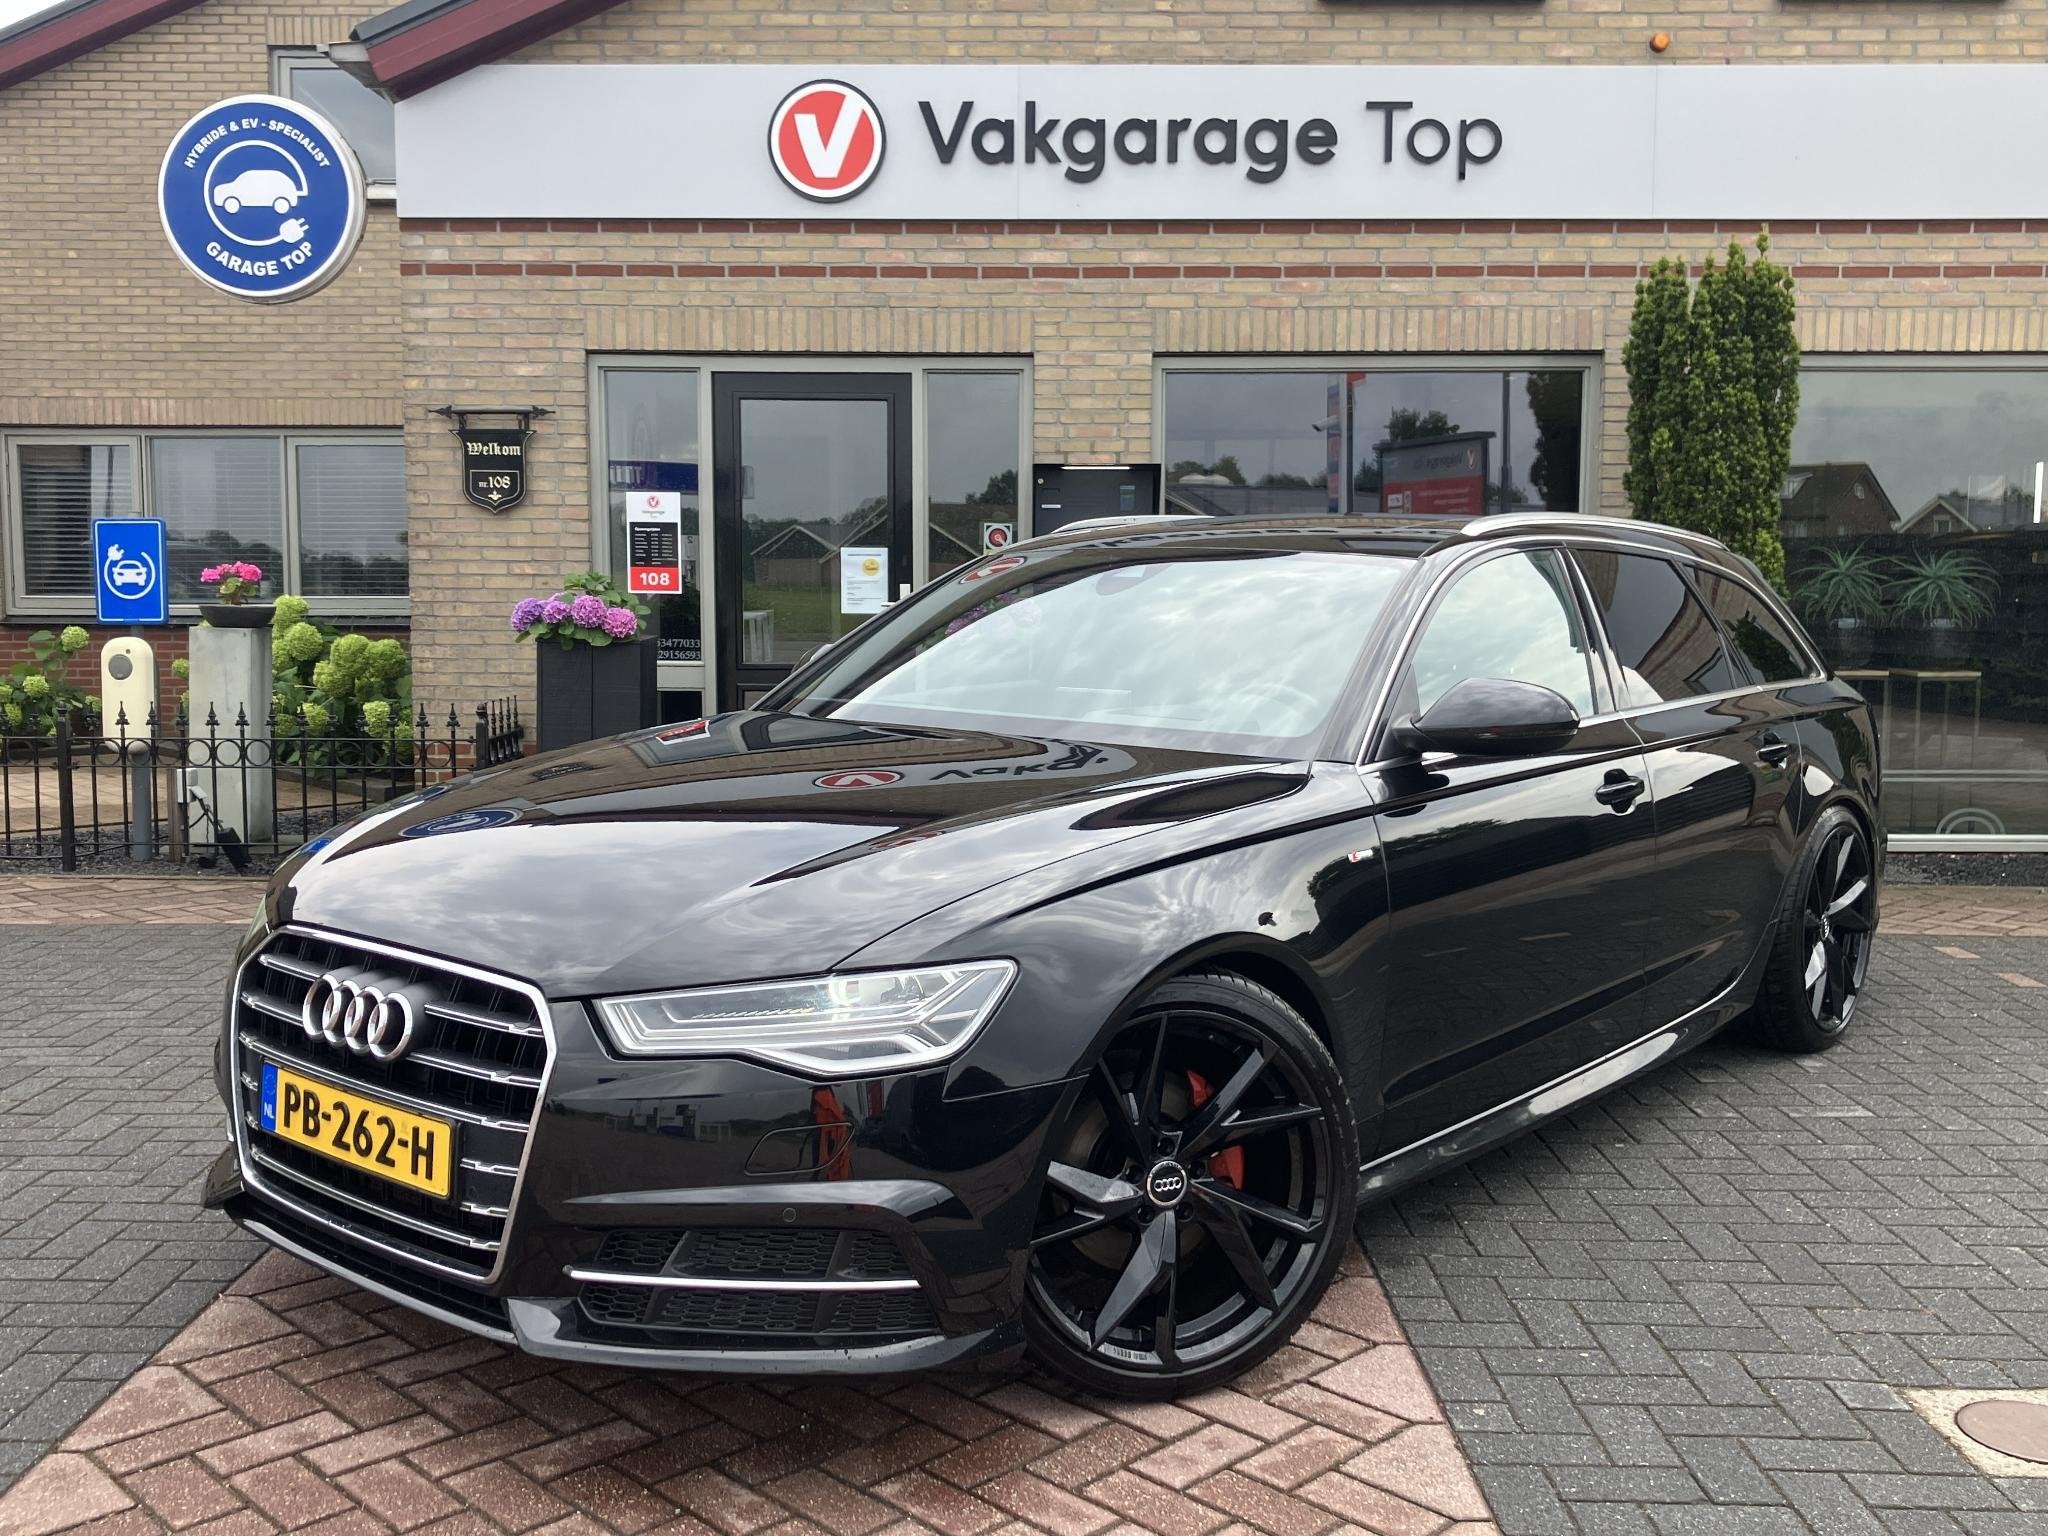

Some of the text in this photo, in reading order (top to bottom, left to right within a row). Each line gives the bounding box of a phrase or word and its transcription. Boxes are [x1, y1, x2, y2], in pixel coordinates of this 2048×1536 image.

[184, 125, 228, 168] HYBRIDE
[229, 121, 239, 132] &
[241, 118, 259, 129] EV
[268, 119, 331, 168] SPECIALIST
[918, 100, 1503, 184] Vakgarage Top
[206, 241, 313, 277] GARAGE TOP
[466, 442, 521, 456] Welkom
[639, 572, 670, 586] 108
[263, 1081, 435, 1181] NL PB-262-H
